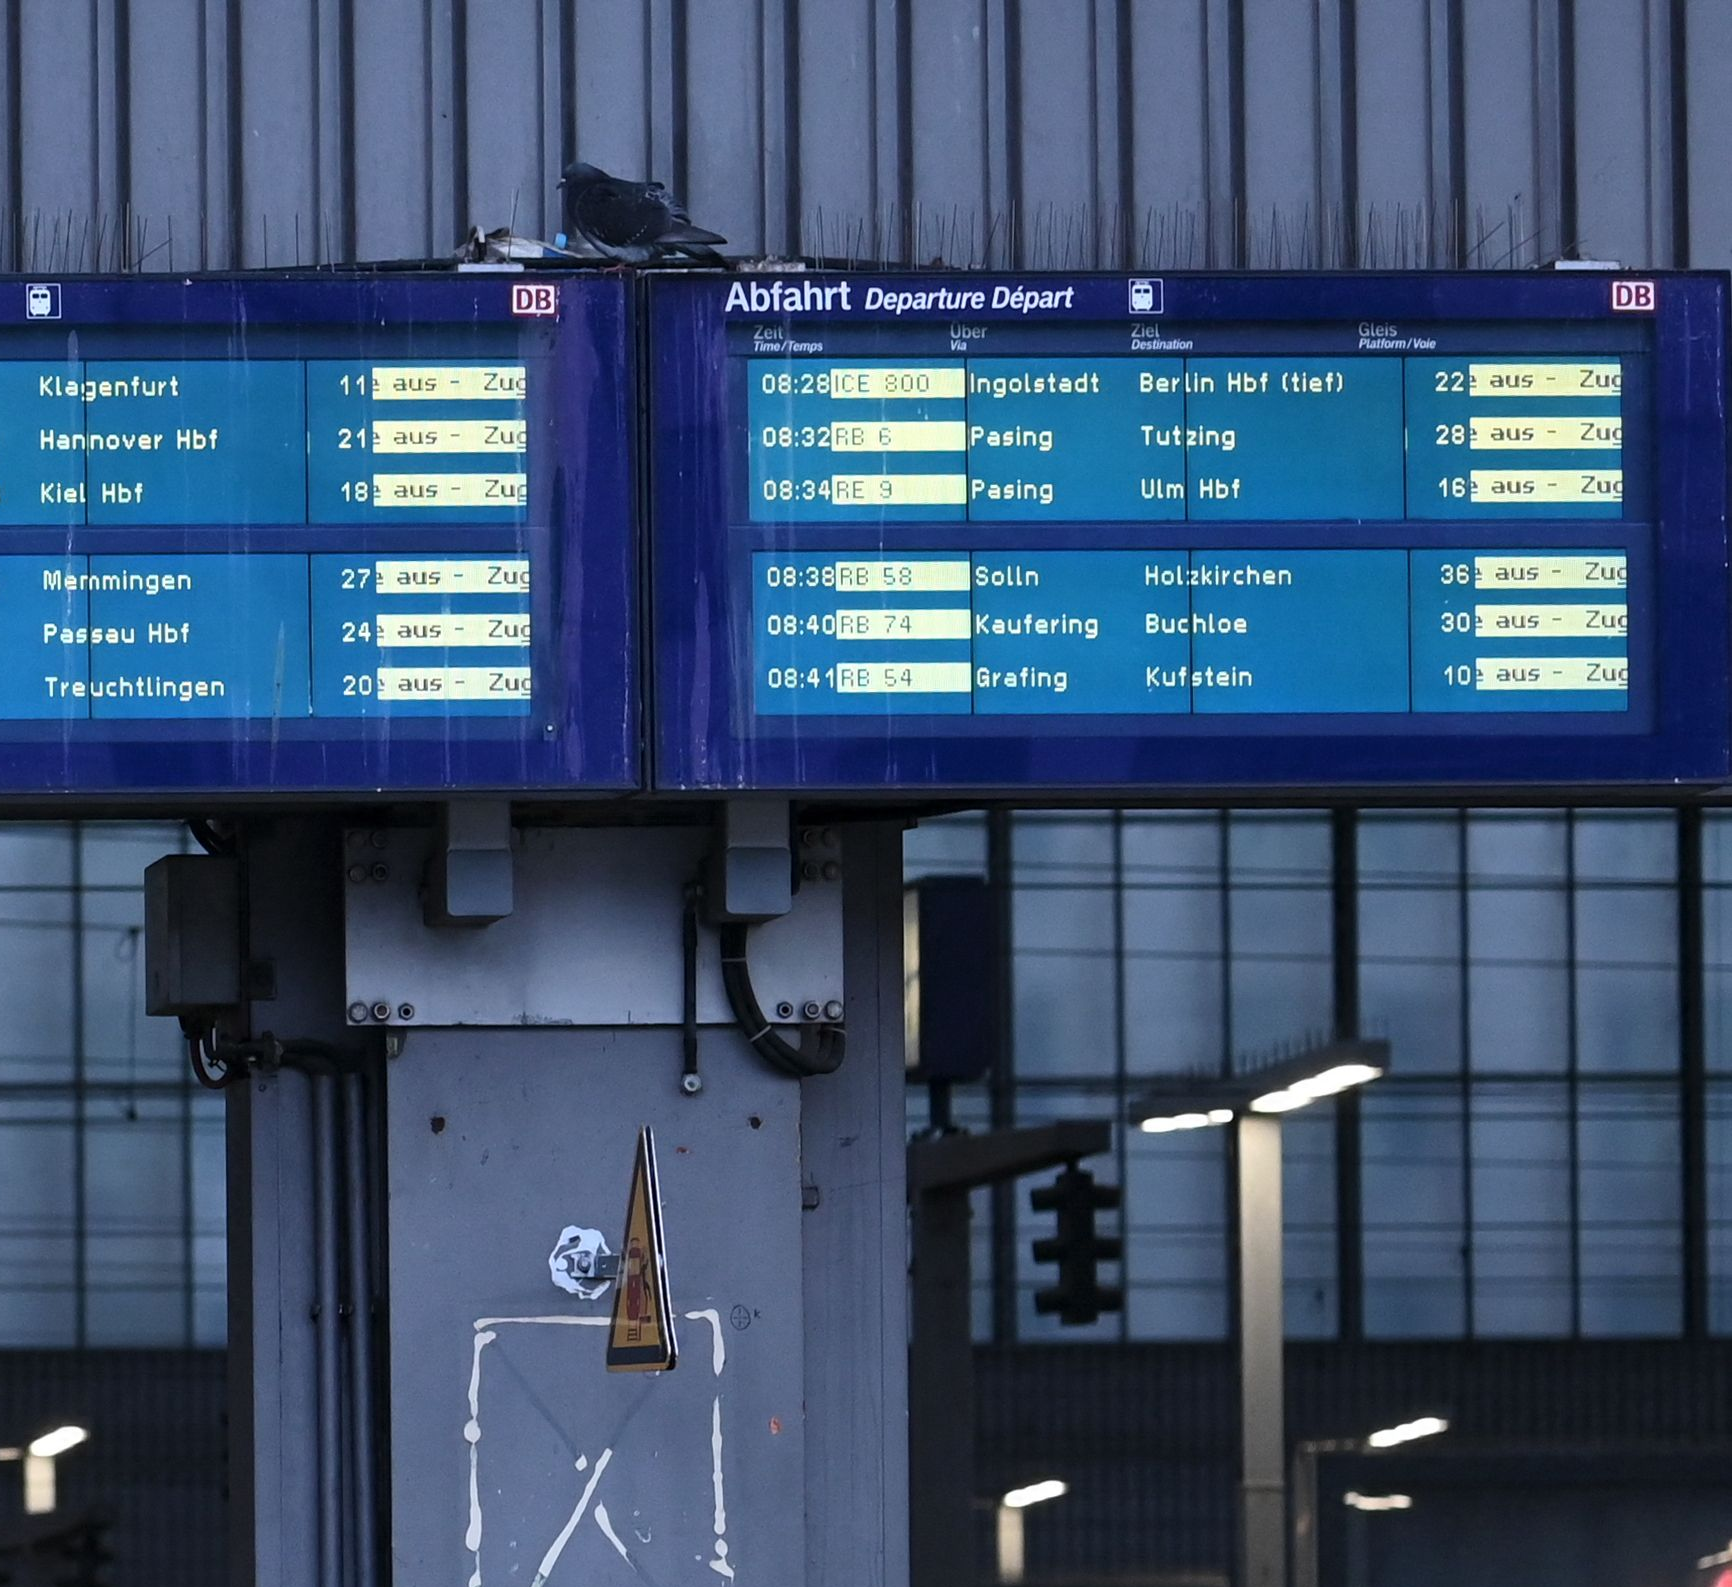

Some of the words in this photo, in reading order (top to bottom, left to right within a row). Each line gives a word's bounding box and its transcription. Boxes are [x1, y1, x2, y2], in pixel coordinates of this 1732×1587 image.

[515, 288, 552, 311] DB
[725, 281, 852, 312] Abfahrt
[865, 286, 986, 316] Departure
[992, 286, 1075, 314] Départ
[1615, 285, 1652, 307] DB
[753, 324, 784, 340] Zeit
[1131, 323, 1160, 338] Ziel
[1358, 321, 1398, 338] Gleis
[753, 340, 824, 354] Time/Temps
[950, 340, 967, 352] Via
[1131, 339, 1194, 351] Destination
[1358, 337, 1437, 350] Platform/Voie
[39, 375, 179, 402] Klagenfurt
[340, 375, 368, 396] 11
[393, 378, 437, 391] aus
[762, 373, 830, 394] 08:28
[835, 374, 870, 393] ICE
[885, 374, 929, 393] 800
[970, 372, 1099, 397] Ingolstadt
[1140, 372, 1214, 393] Berlin
[1228, 372, 1268, 393] Hbf
[1282, 372, 1344, 394] (tief)
[1435, 372, 1465, 393] 22
[1490, 374, 1533, 388] aus
[40, 428, 163, 451] Hannover
[177, 428, 219, 450] Hbf
[338, 428, 368, 449] 21
[394, 431, 437, 445] aus
[762, 427, 830, 448] 08:32
[836, 427, 864, 446] RB
[879, 427, 892, 446] 6
[970, 426, 1053, 451] Pasing
[1141, 425, 1236, 451] Tutzing
[1436, 425, 1466, 445] 28
[1491, 428, 1534, 441] aus
[40, 482, 85, 504] Kiel
[102, 482, 143, 504] Hbf
[341, 482, 368, 503] 18
[394, 485, 438, 498] aus
[763, 480, 831, 500] 08:34
[836, 481, 864, 499] RE
[879, 481, 892, 499] 9
[971, 479, 1053, 503] Pasing
[1141, 479, 1184, 500] Ulm
[1199, 478, 1241, 499] Hbf
[1439, 478, 1466, 498] 16
[1491, 480, 1535, 494] aus
[43, 569, 191, 595] Memmingen
[341, 569, 370, 590] 27
[397, 572, 441, 585] aus
[767, 566, 835, 587] 08:38
[840, 567, 869, 586] RB
[883, 567, 912, 586] 58
[975, 565, 1039, 586] Solln
[1145, 564, 1292, 586] Holzkirchen
[1440, 564, 1469, 585] 36
[1495, 567, 1539, 580] aus
[43, 622, 135, 644] Passau
[148, 622, 190, 644] Hbf
[342, 622, 371, 643] 24
[397, 625, 441, 638] aus
[767, 615, 835, 635] 08:40
[840, 615, 869, 634] RB
[883, 615, 912, 634] 74
[976, 614, 1099, 639] Kaufering
[1145, 613, 1248, 635] Buchloe
[1440, 612, 1470, 633] 30
[1496, 615, 1539, 628] aus
[45, 676, 225, 702] Treuchtlingen
[343, 676, 372, 696] 20
[398, 678, 442, 691] aus
[768, 668, 835, 688] 08:41
[841, 668, 869, 687] RB
[884, 668, 912, 687] 54
[976, 667, 1068, 692] Grafing
[1146, 666, 1253, 688] Kufstein
[1444, 666, 1471, 686] 10
[1497, 668, 1540, 682] aus
